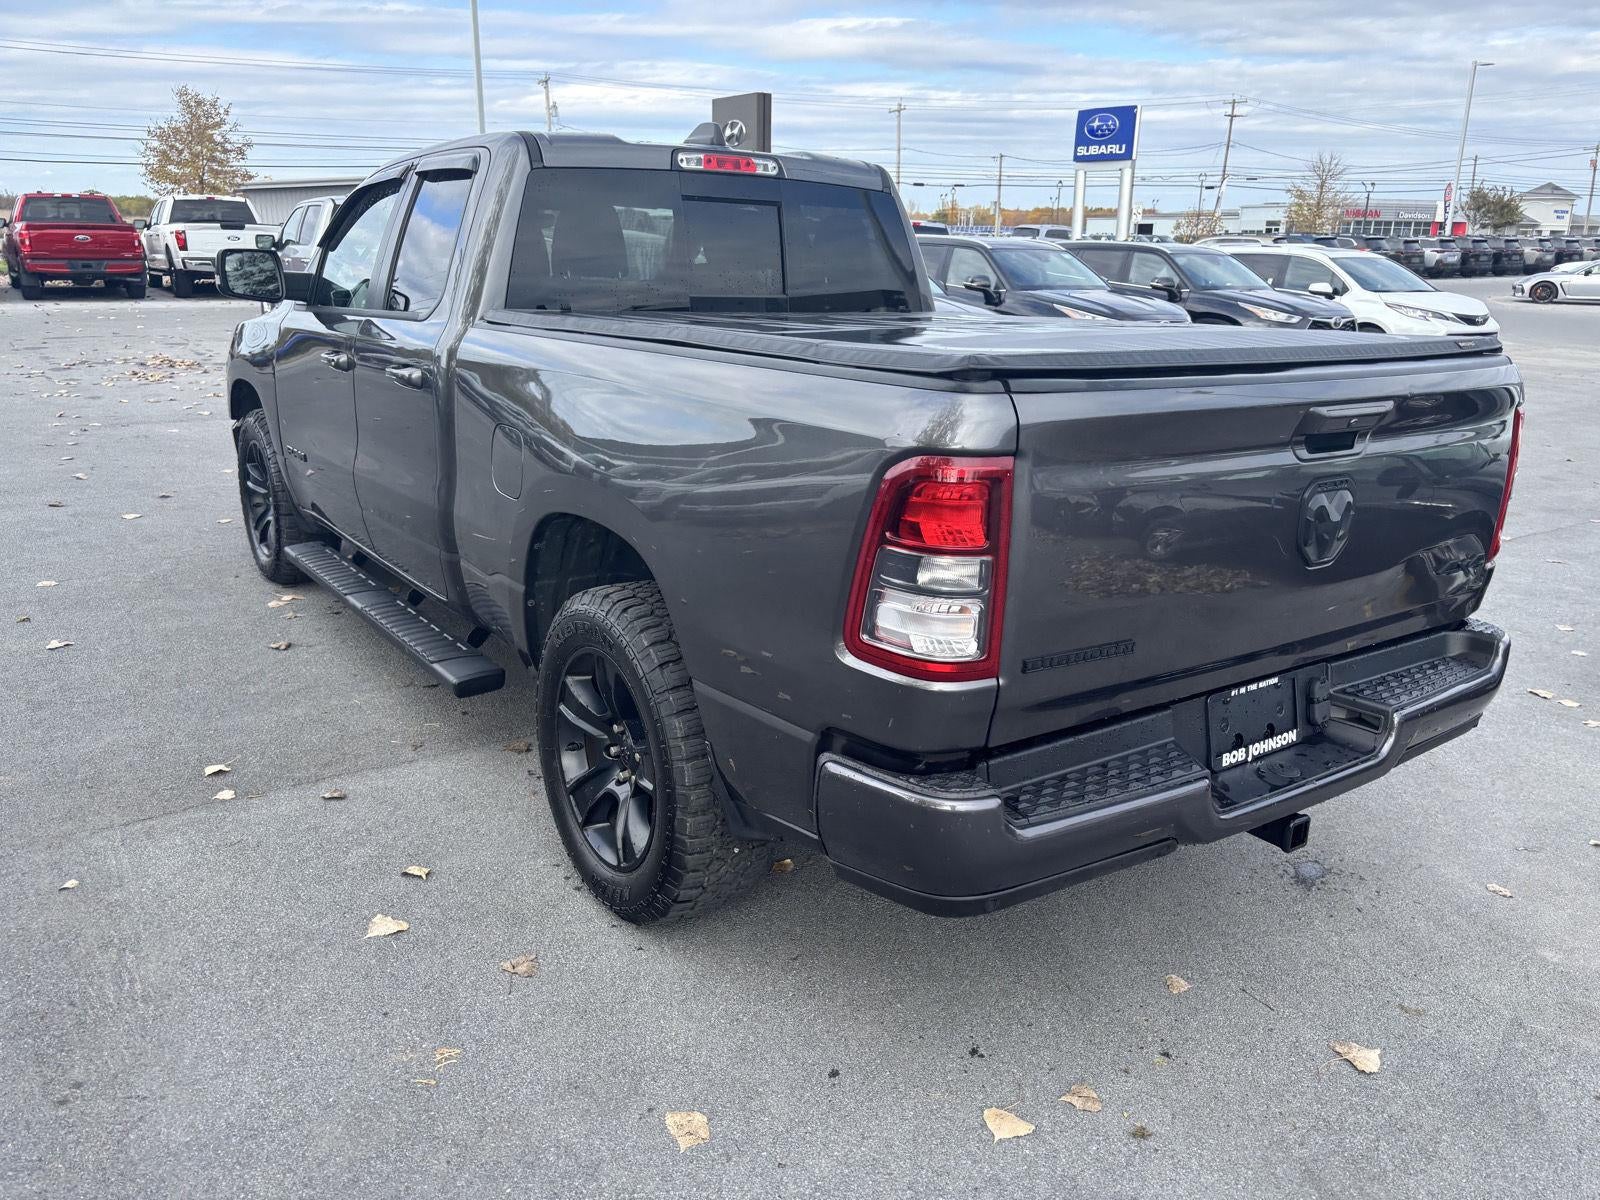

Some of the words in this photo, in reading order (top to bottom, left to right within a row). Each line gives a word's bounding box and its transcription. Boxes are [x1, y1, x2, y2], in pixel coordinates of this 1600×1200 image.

[1077, 143, 1126, 156] SUBARU
[1344, 208, 1381, 219] NISSAN
[1398, 210, 1430, 219] Davidson
[1231, 689, 1239, 697] #1
[1247, 684, 1258, 692] THE
[1259, 677, 1279, 689] NATION
[1222, 747, 1246, 767] BOB
[1247, 729, 1297, 762] JOHNSON
